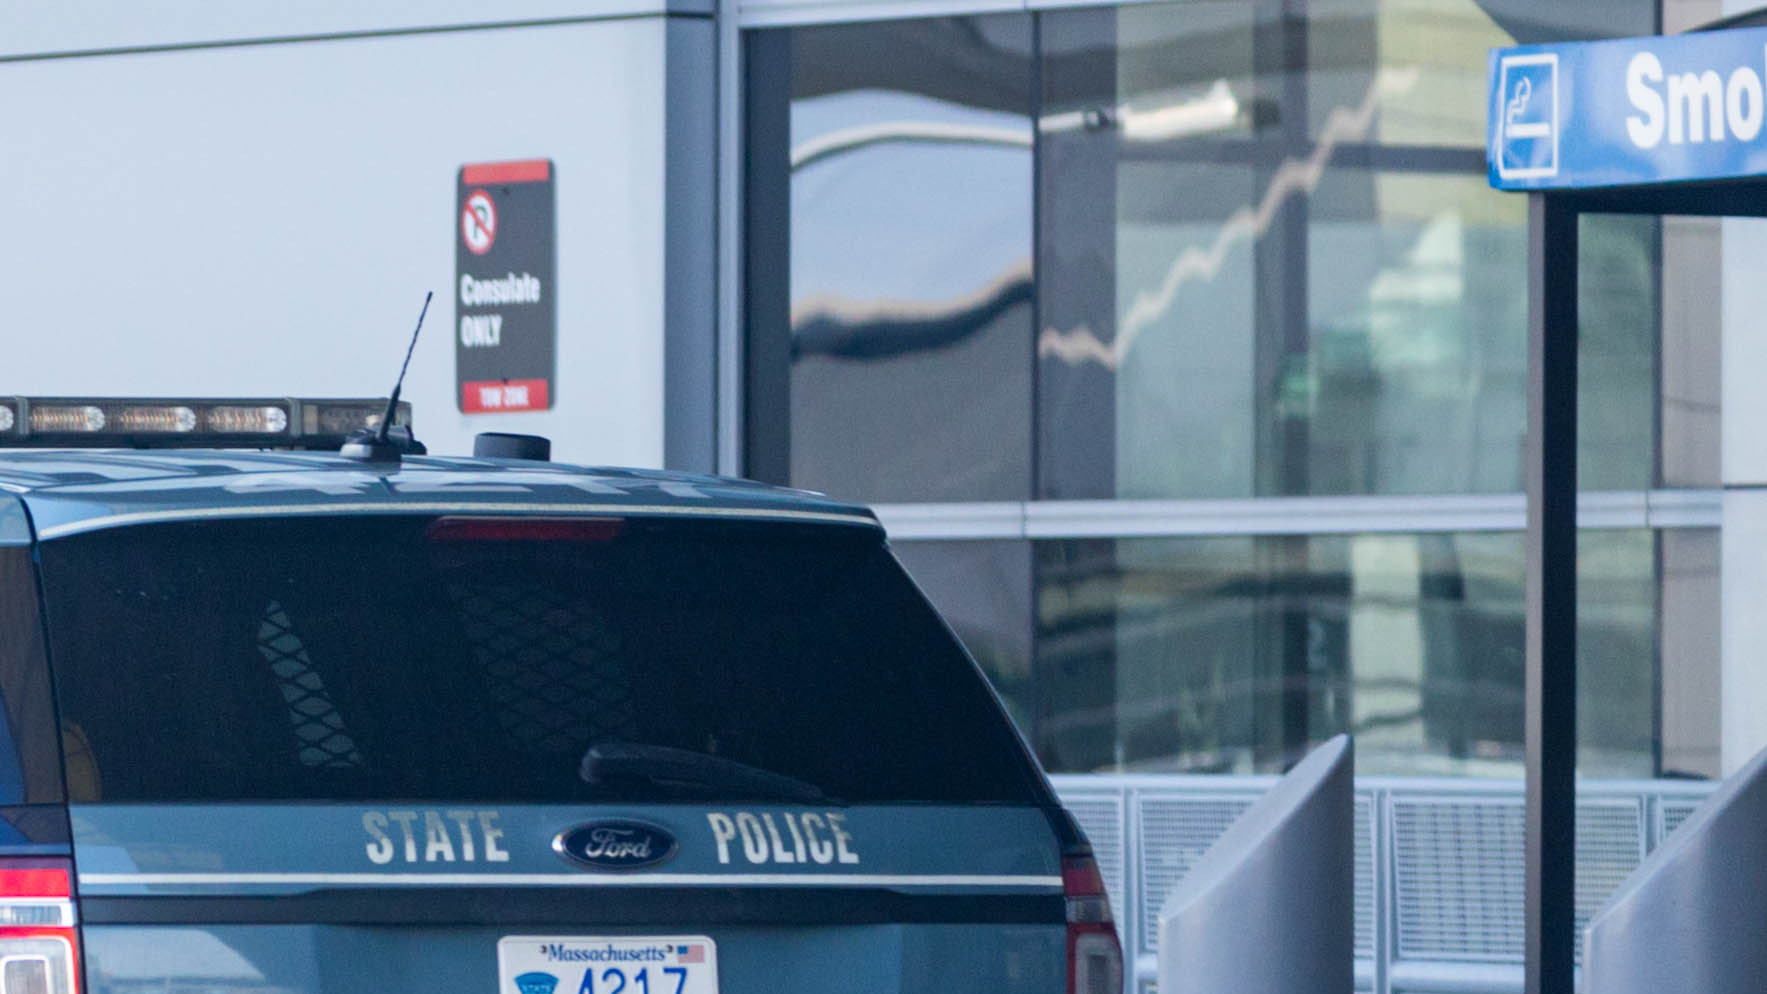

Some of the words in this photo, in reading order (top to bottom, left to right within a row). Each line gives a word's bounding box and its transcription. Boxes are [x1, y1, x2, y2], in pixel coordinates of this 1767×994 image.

[1625, 43, 1767, 150] Smo
[461, 272, 541, 306] Consulate
[461, 314, 503, 347] ONLY
[362, 811, 510, 864] STATE
[585, 828, 653, 859] Ford
[706, 811, 860, 865] POLICE
[548, 943, 666, 962] Massachusetts
